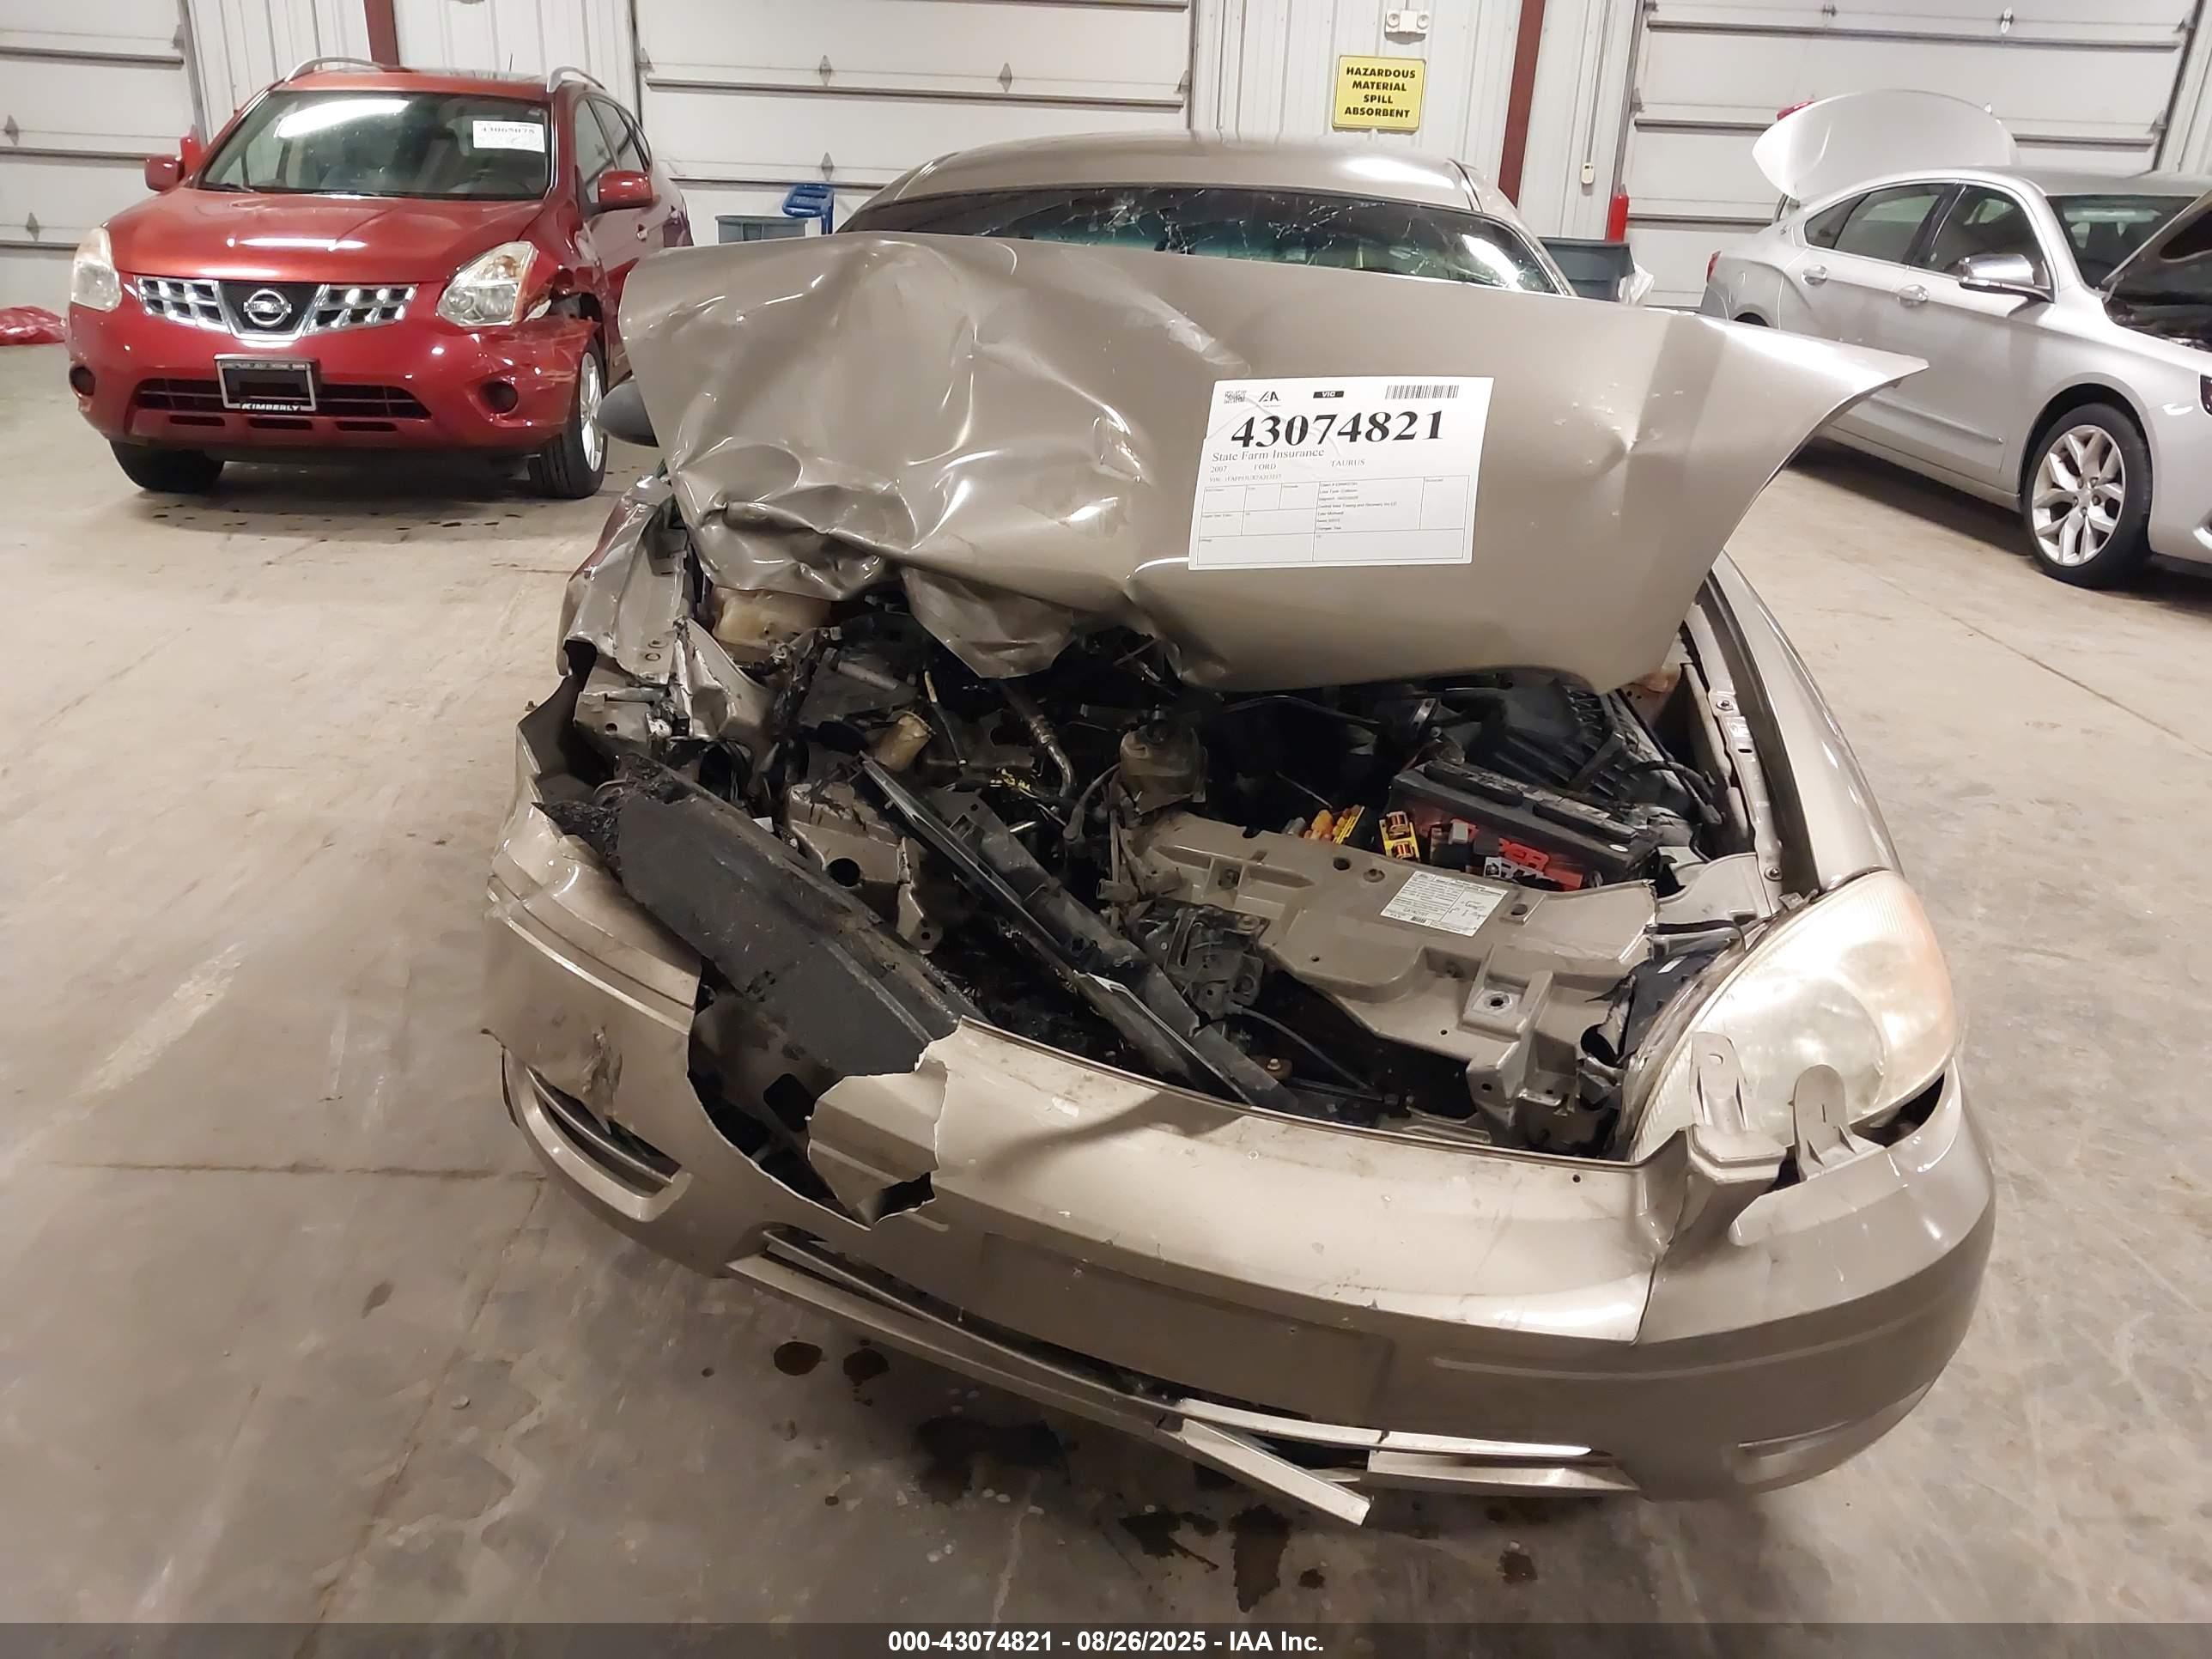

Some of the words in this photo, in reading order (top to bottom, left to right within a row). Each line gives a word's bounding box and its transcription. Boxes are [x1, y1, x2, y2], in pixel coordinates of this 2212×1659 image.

[1346, 66, 1416, 78] HAZARDOUS
[1352, 80, 1407, 91] MATERIAL
[1363, 94, 1394, 104] SPILL
[1344, 106, 1411, 118] ABSORBENT
[241, 403, 300, 411] KIMBERLY
[1231, 410, 1443, 448] 43074821
[1212, 452, 1238, 462] State
[1241, 451, 1269, 460] Farm
[1273, 449, 1325, 459] Insurance
[1254, 463, 1277, 471] FORD
[1331, 459, 1366, 467] TAURUS
